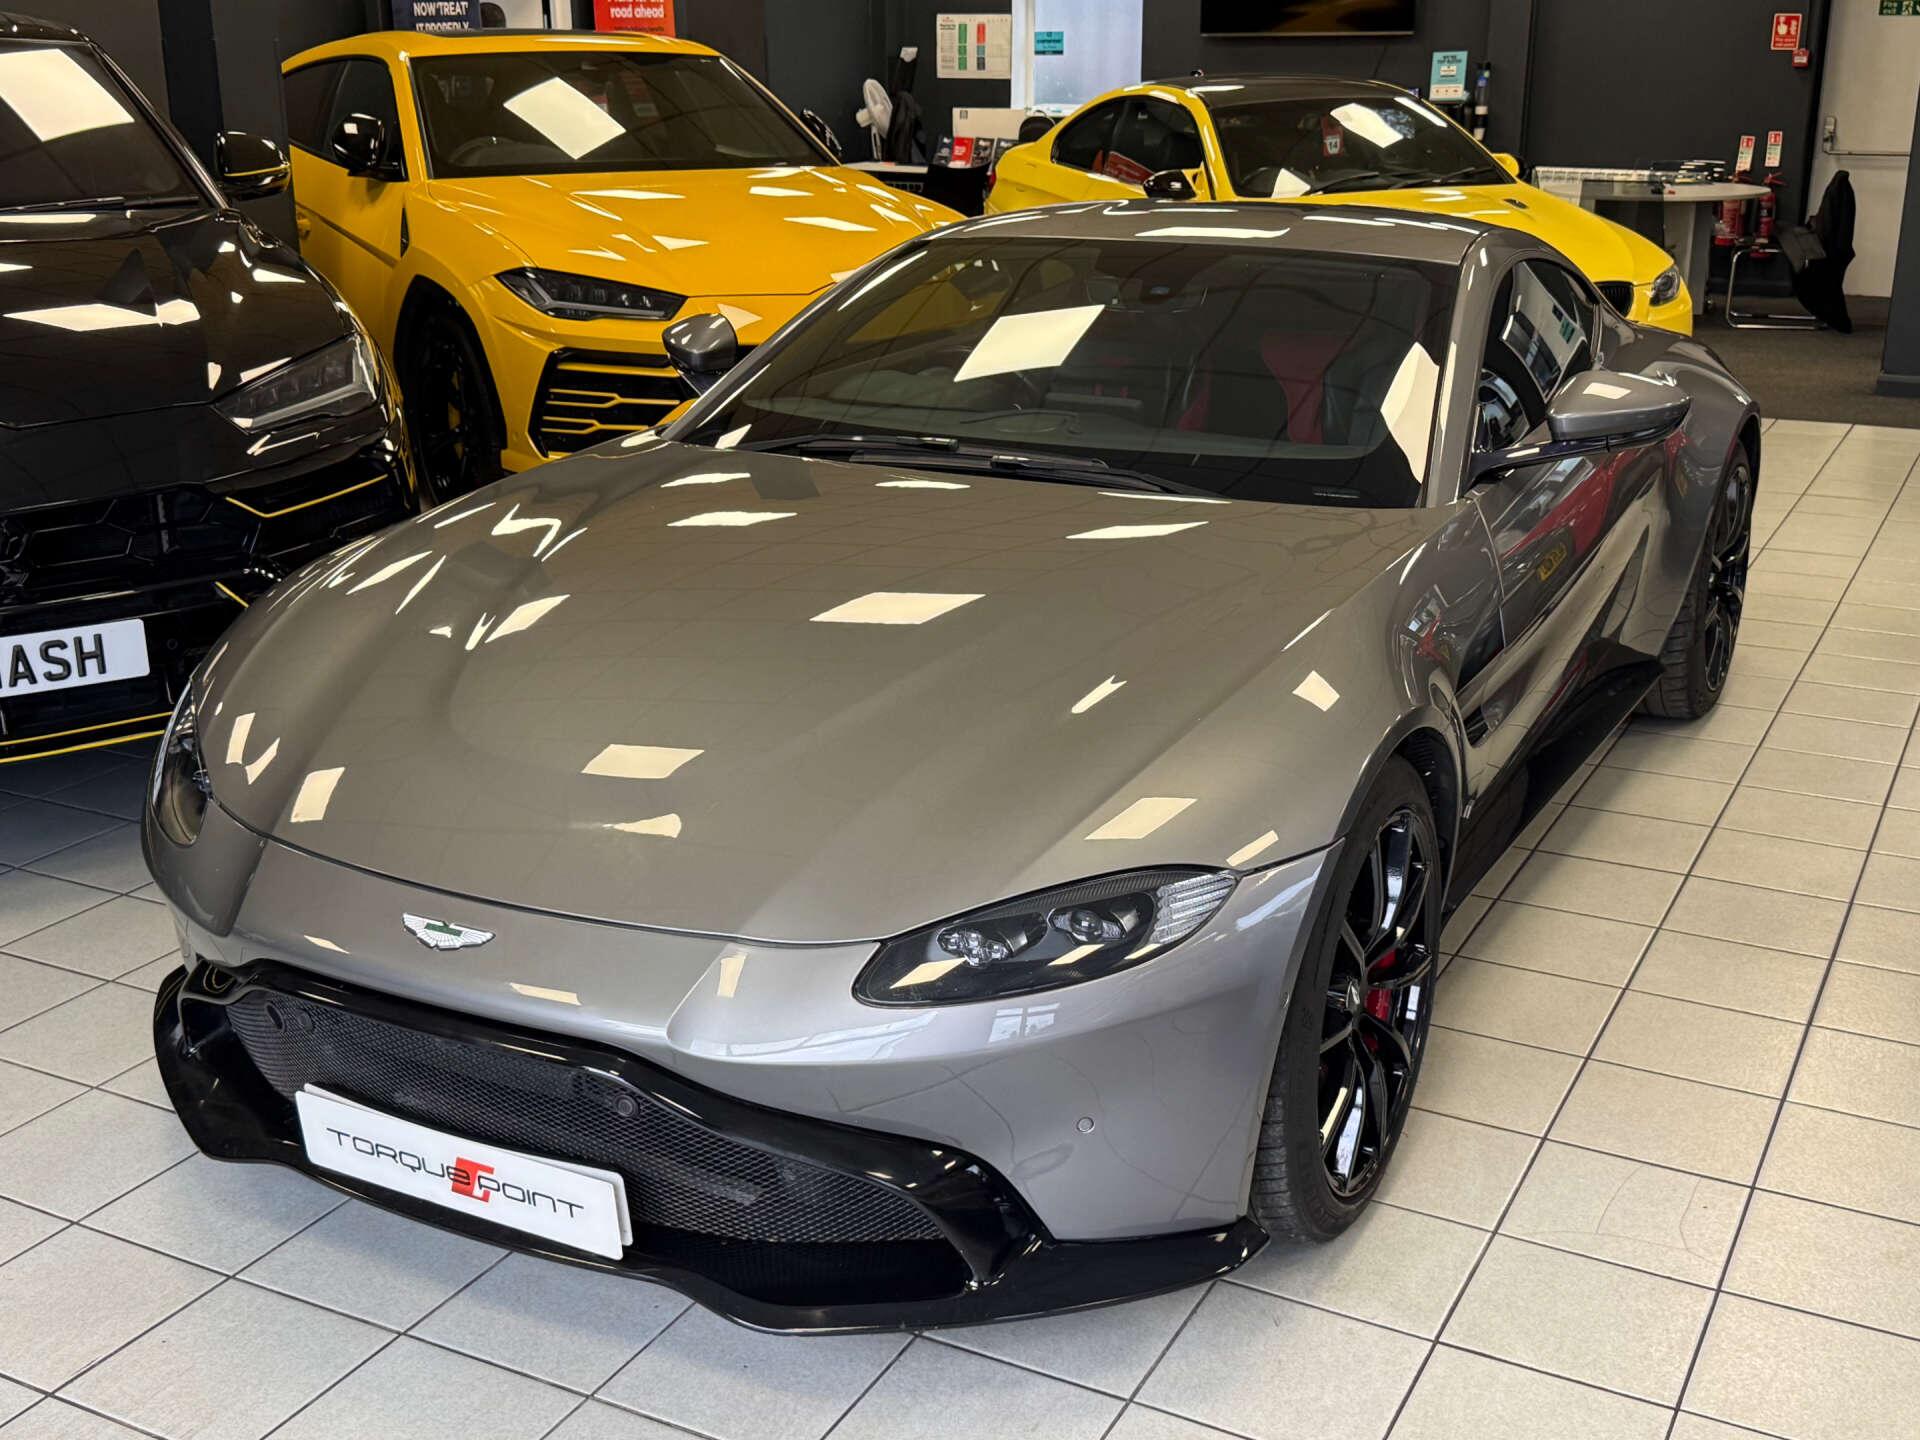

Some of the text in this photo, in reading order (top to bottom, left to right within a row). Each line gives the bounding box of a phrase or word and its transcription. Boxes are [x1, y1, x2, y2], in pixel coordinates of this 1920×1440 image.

[413, 2, 435, 17] NOW
[610, 5, 665, 18] road ahead
[0, 633, 107, 689] ASH
[326, 1127, 471, 1187] TORQUE
